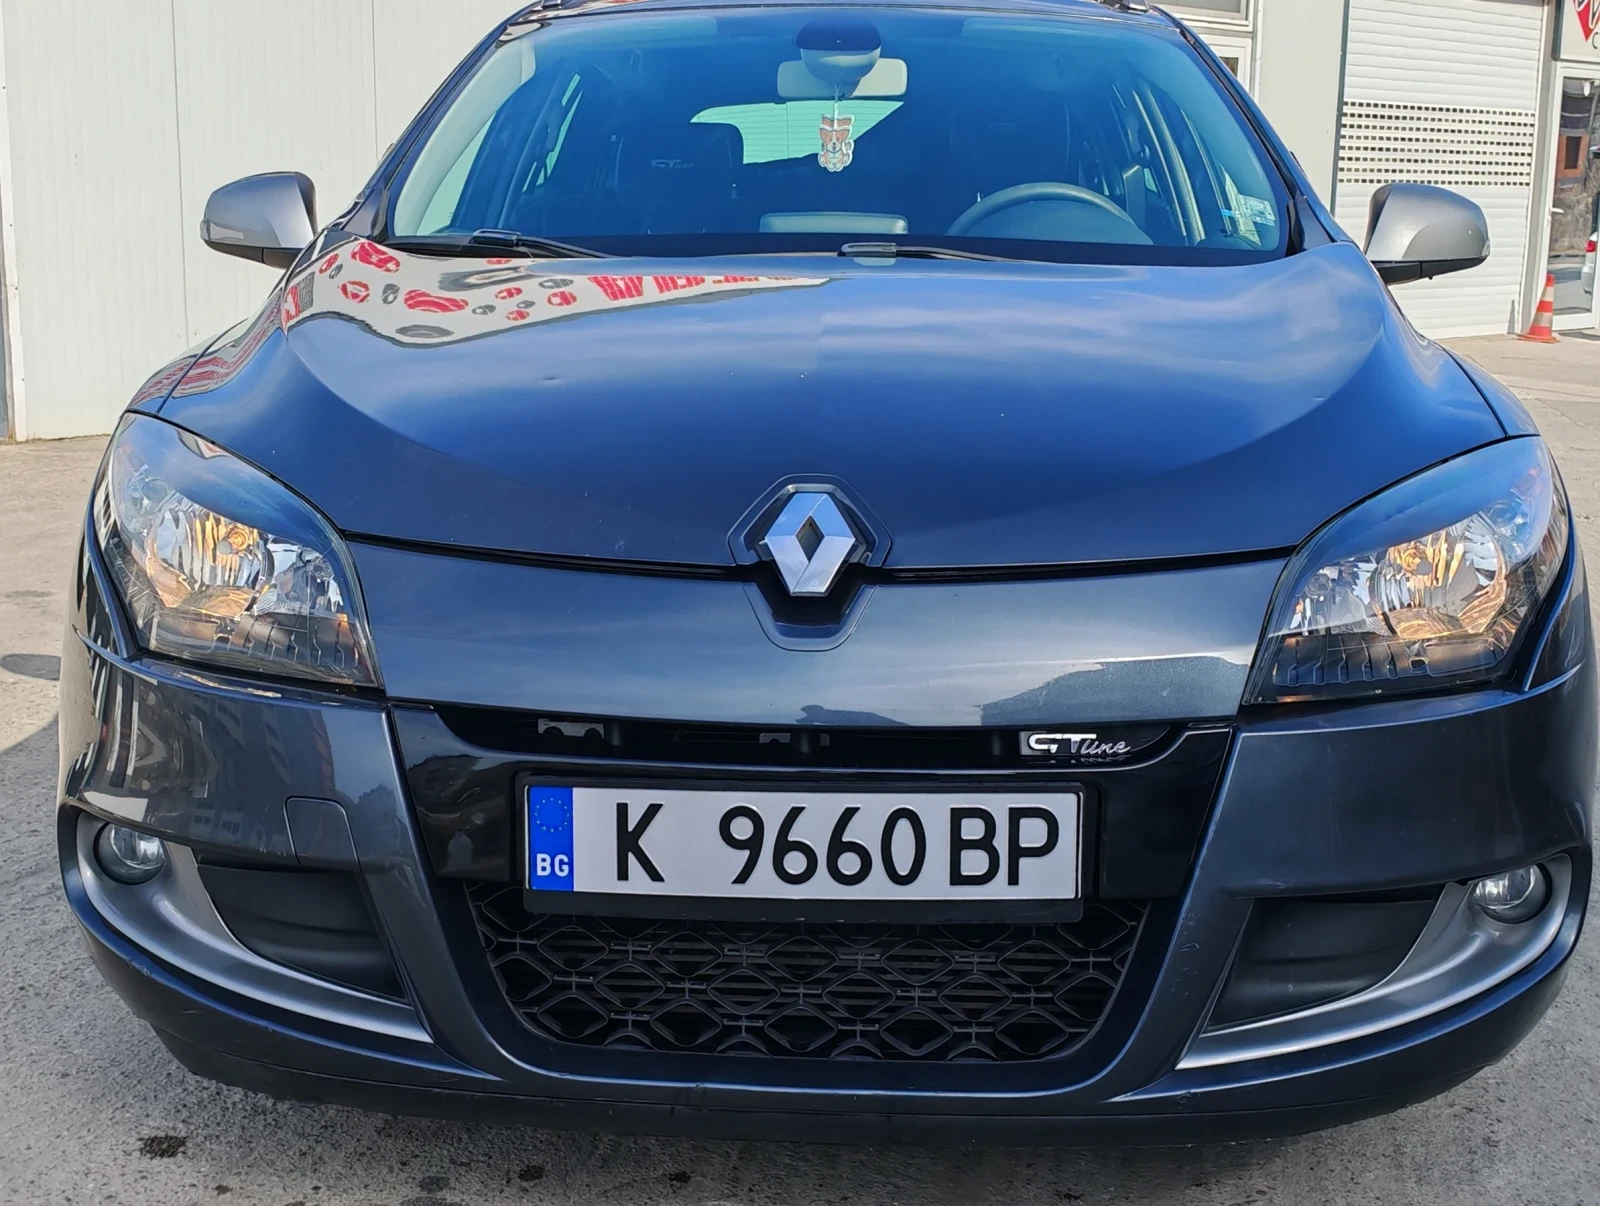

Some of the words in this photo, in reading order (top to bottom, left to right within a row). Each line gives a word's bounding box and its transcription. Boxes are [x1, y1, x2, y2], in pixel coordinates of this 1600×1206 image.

[536, 853, 570, 878] BG
[616, 802, 666, 883] K
[718, 805, 927, 887] 9660
[949, 806, 1060, 887] BP
